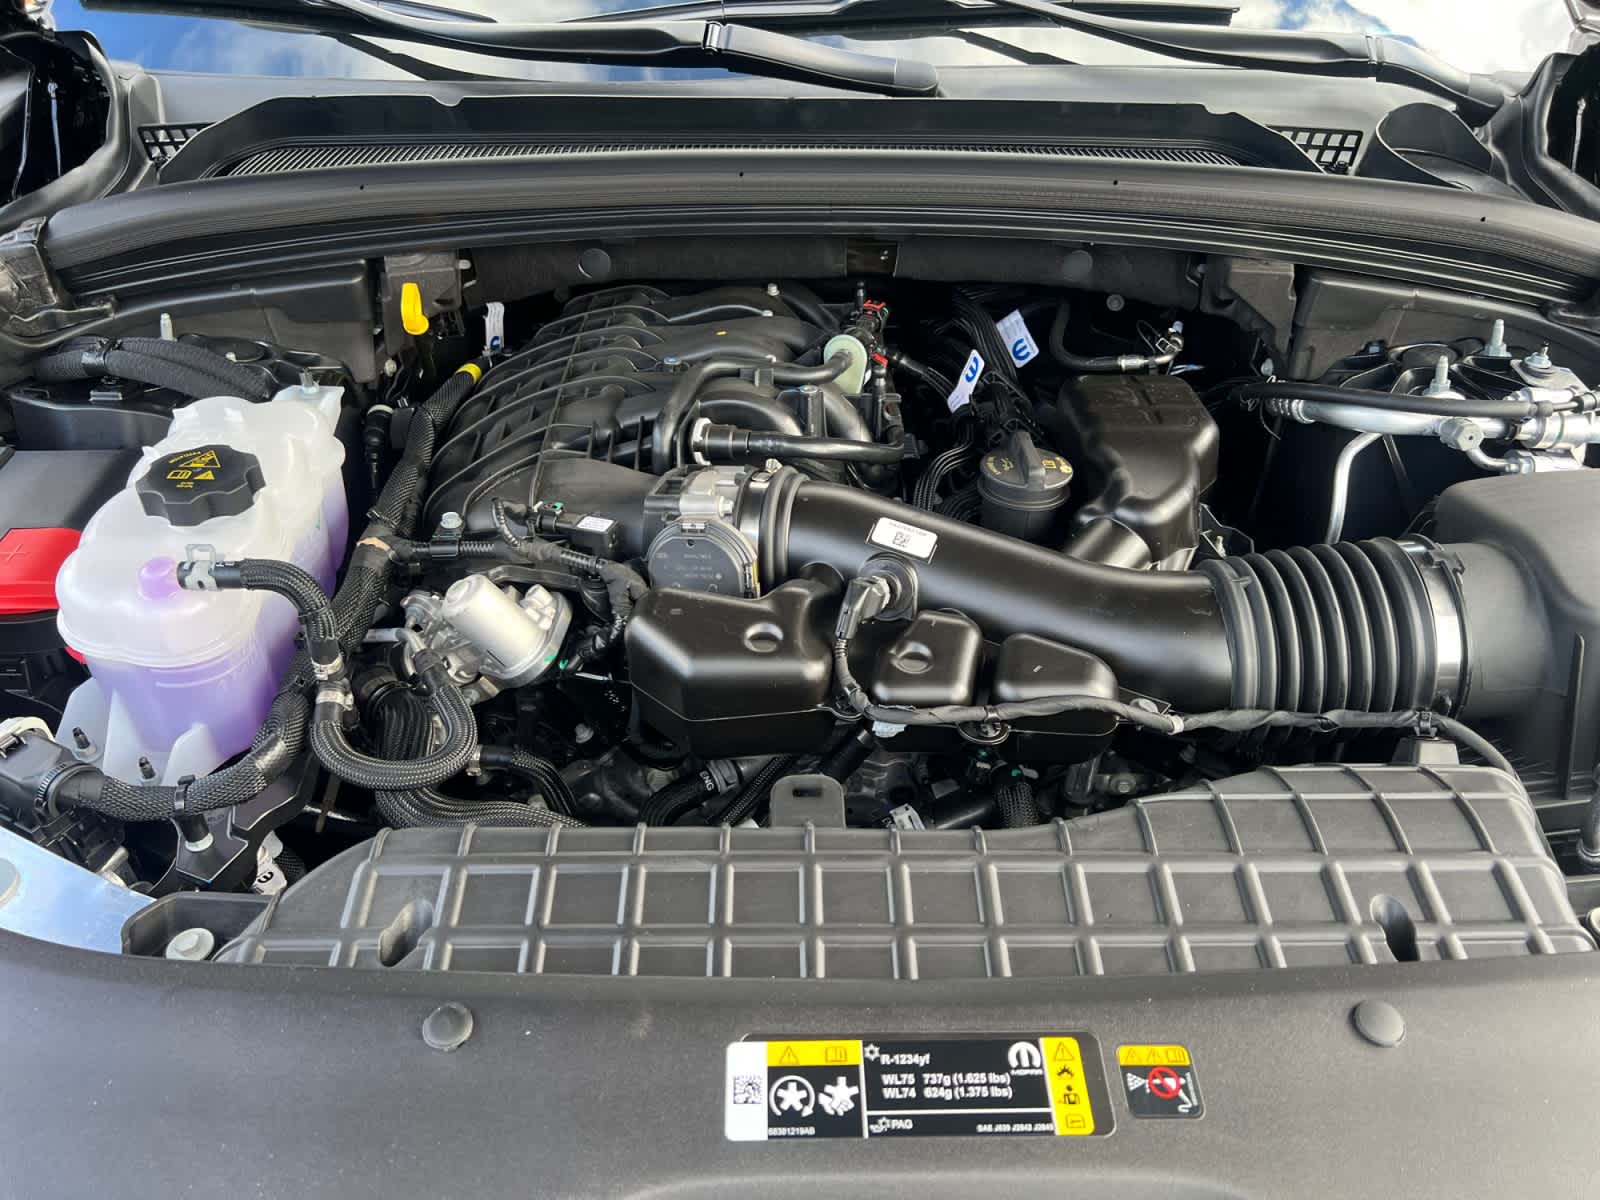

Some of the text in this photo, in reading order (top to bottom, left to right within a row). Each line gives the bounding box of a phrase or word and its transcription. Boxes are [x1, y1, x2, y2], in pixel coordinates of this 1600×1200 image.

[880, 1052, 931, 1067] R-1234yf
[881, 1073, 916, 1086] WL75
[922, 1072, 951, 1087] 737g
[988, 1072, 1011, 1085] lbs)
[882, 1087, 916, 1099] WL74
[923, 1086, 953, 1100] 624g
[990, 1085, 1013, 1099] lbs)
[891, 1119, 913, 1130] PAG
